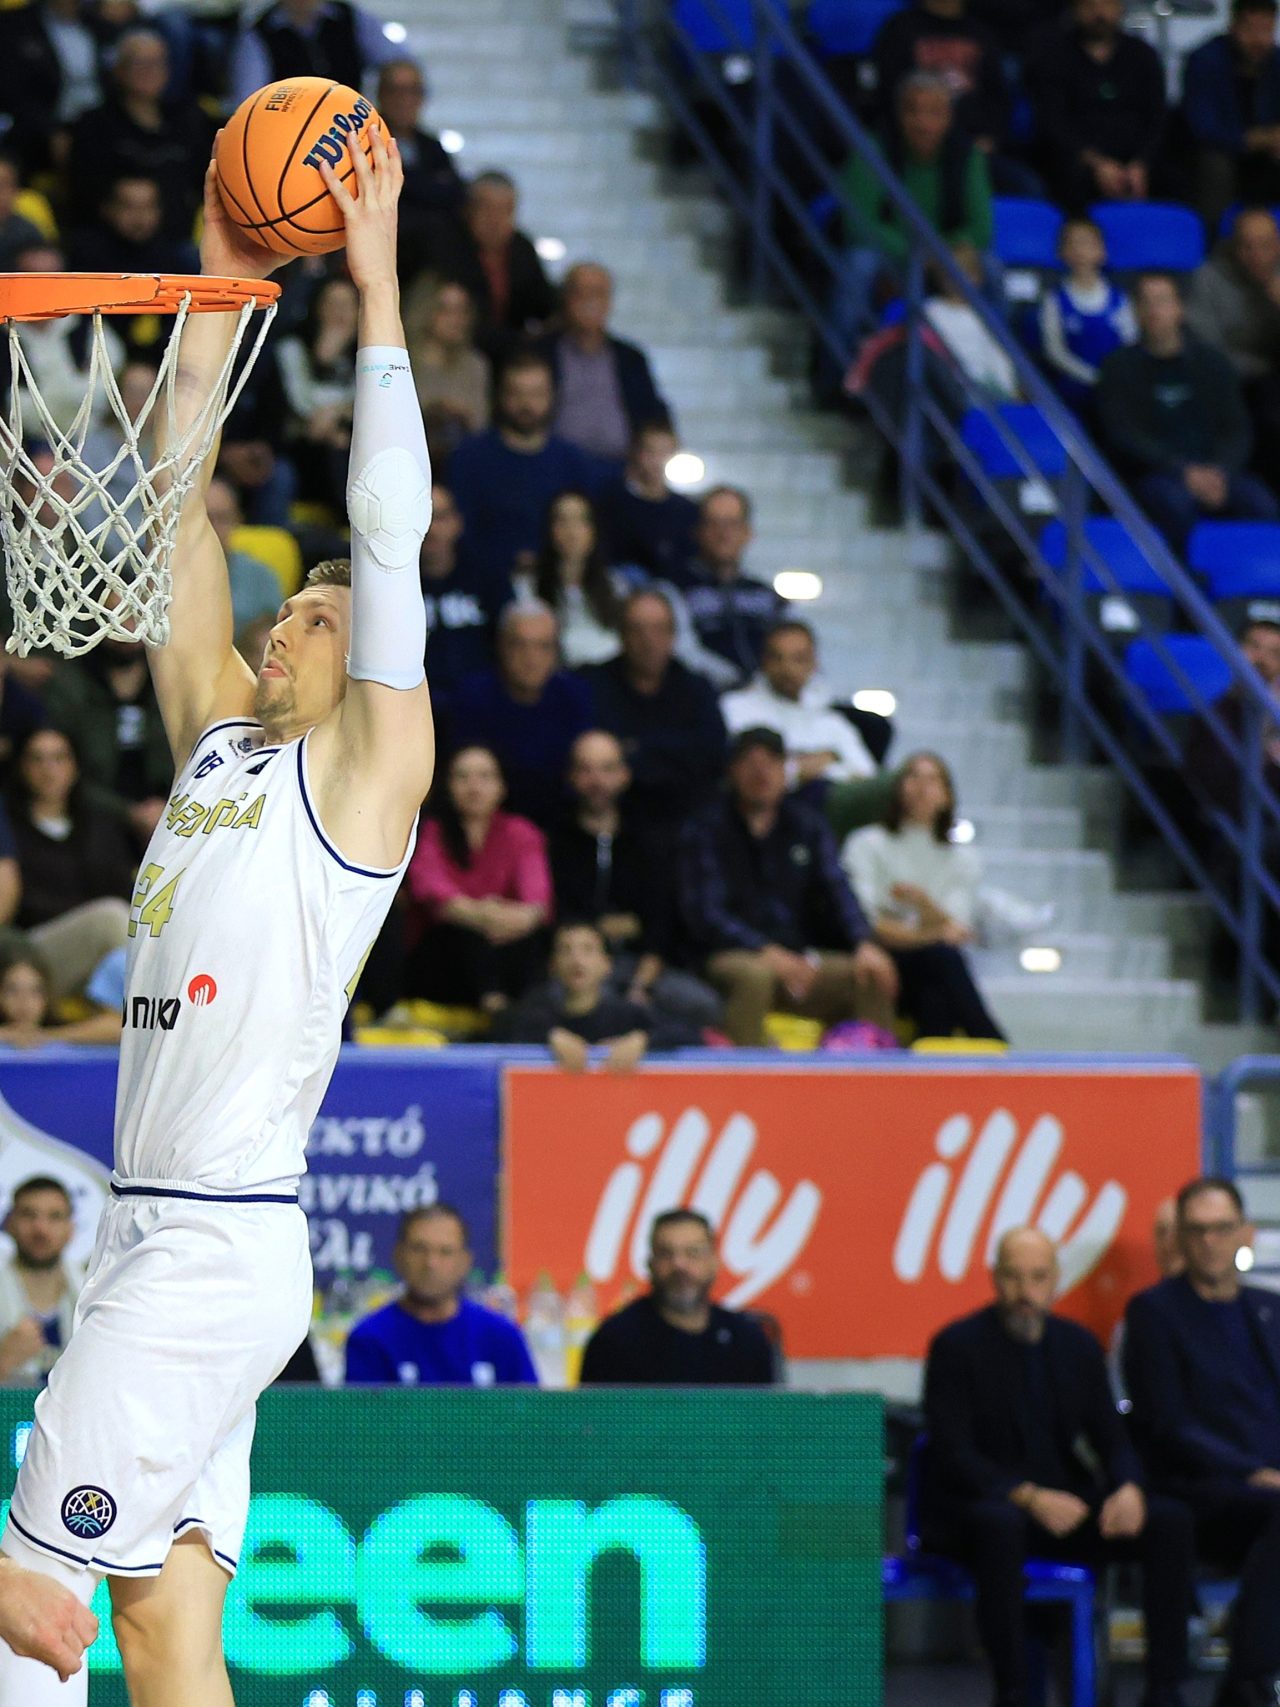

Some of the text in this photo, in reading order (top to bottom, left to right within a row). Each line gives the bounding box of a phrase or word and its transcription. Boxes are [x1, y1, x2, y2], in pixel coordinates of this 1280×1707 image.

[302, 96, 373, 171] Wilson
[128, 862, 187, 938] 24
[586, 1106, 821, 1310] illy
[893, 1107, 1126, 1300] illy
